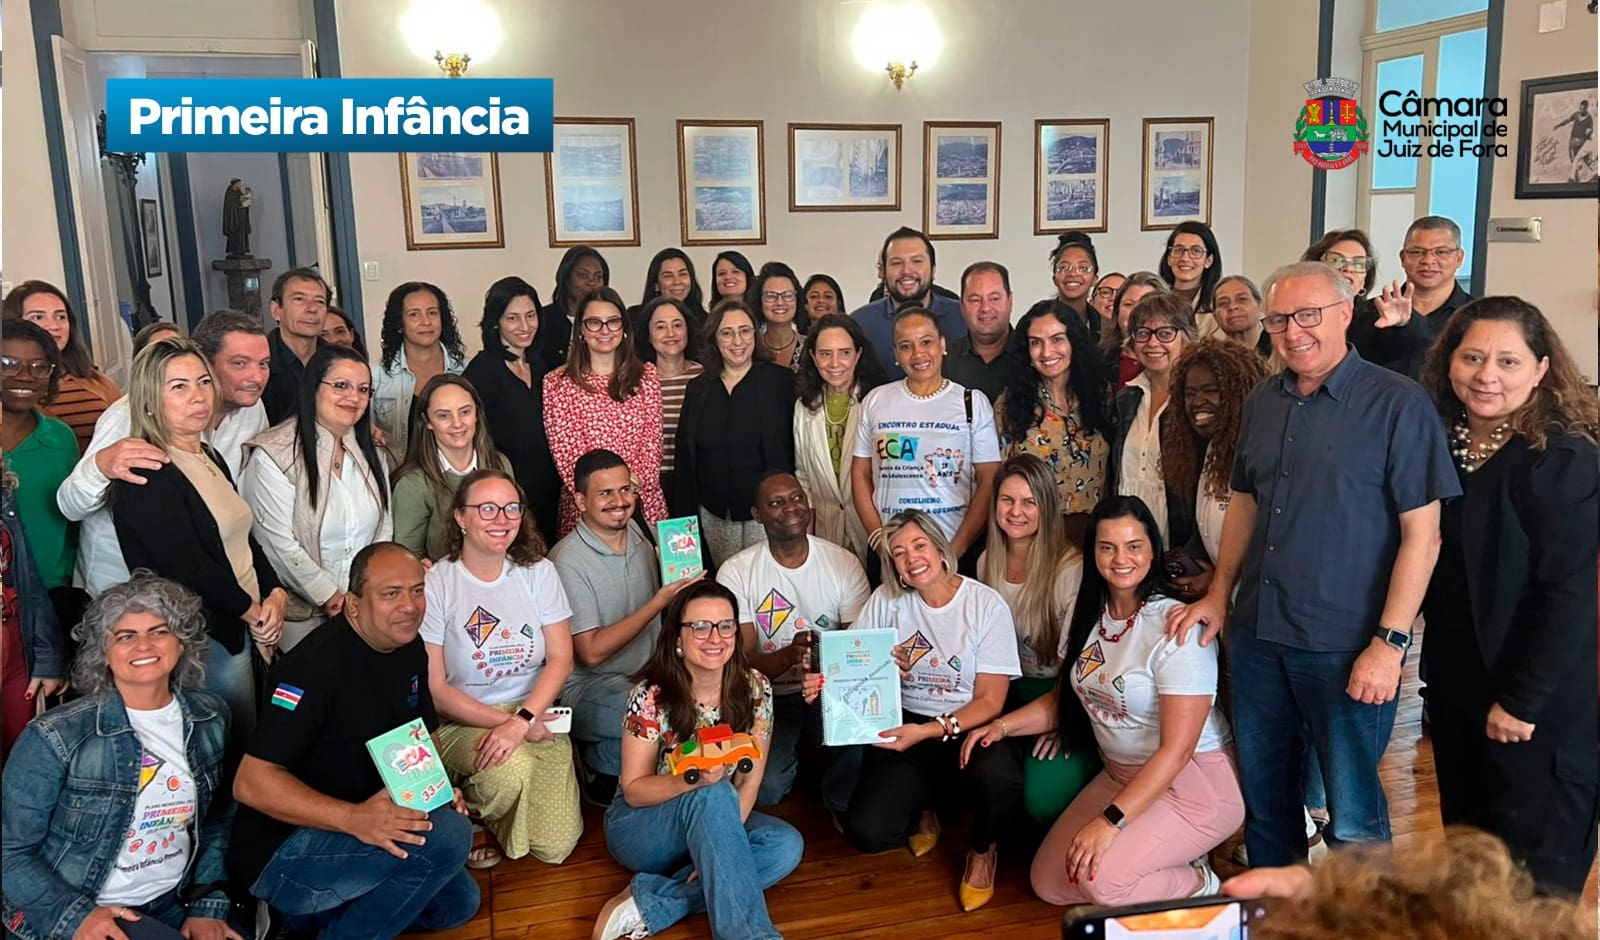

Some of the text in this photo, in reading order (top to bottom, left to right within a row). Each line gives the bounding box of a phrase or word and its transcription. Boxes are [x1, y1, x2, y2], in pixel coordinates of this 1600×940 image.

[878, 421, 960, 431] ENCONTRO ESTADUAL
[877, 438, 915, 460] ECA
[422, 785, 436, 802] 33
[143, 805, 194, 820] PRIMEIRA
